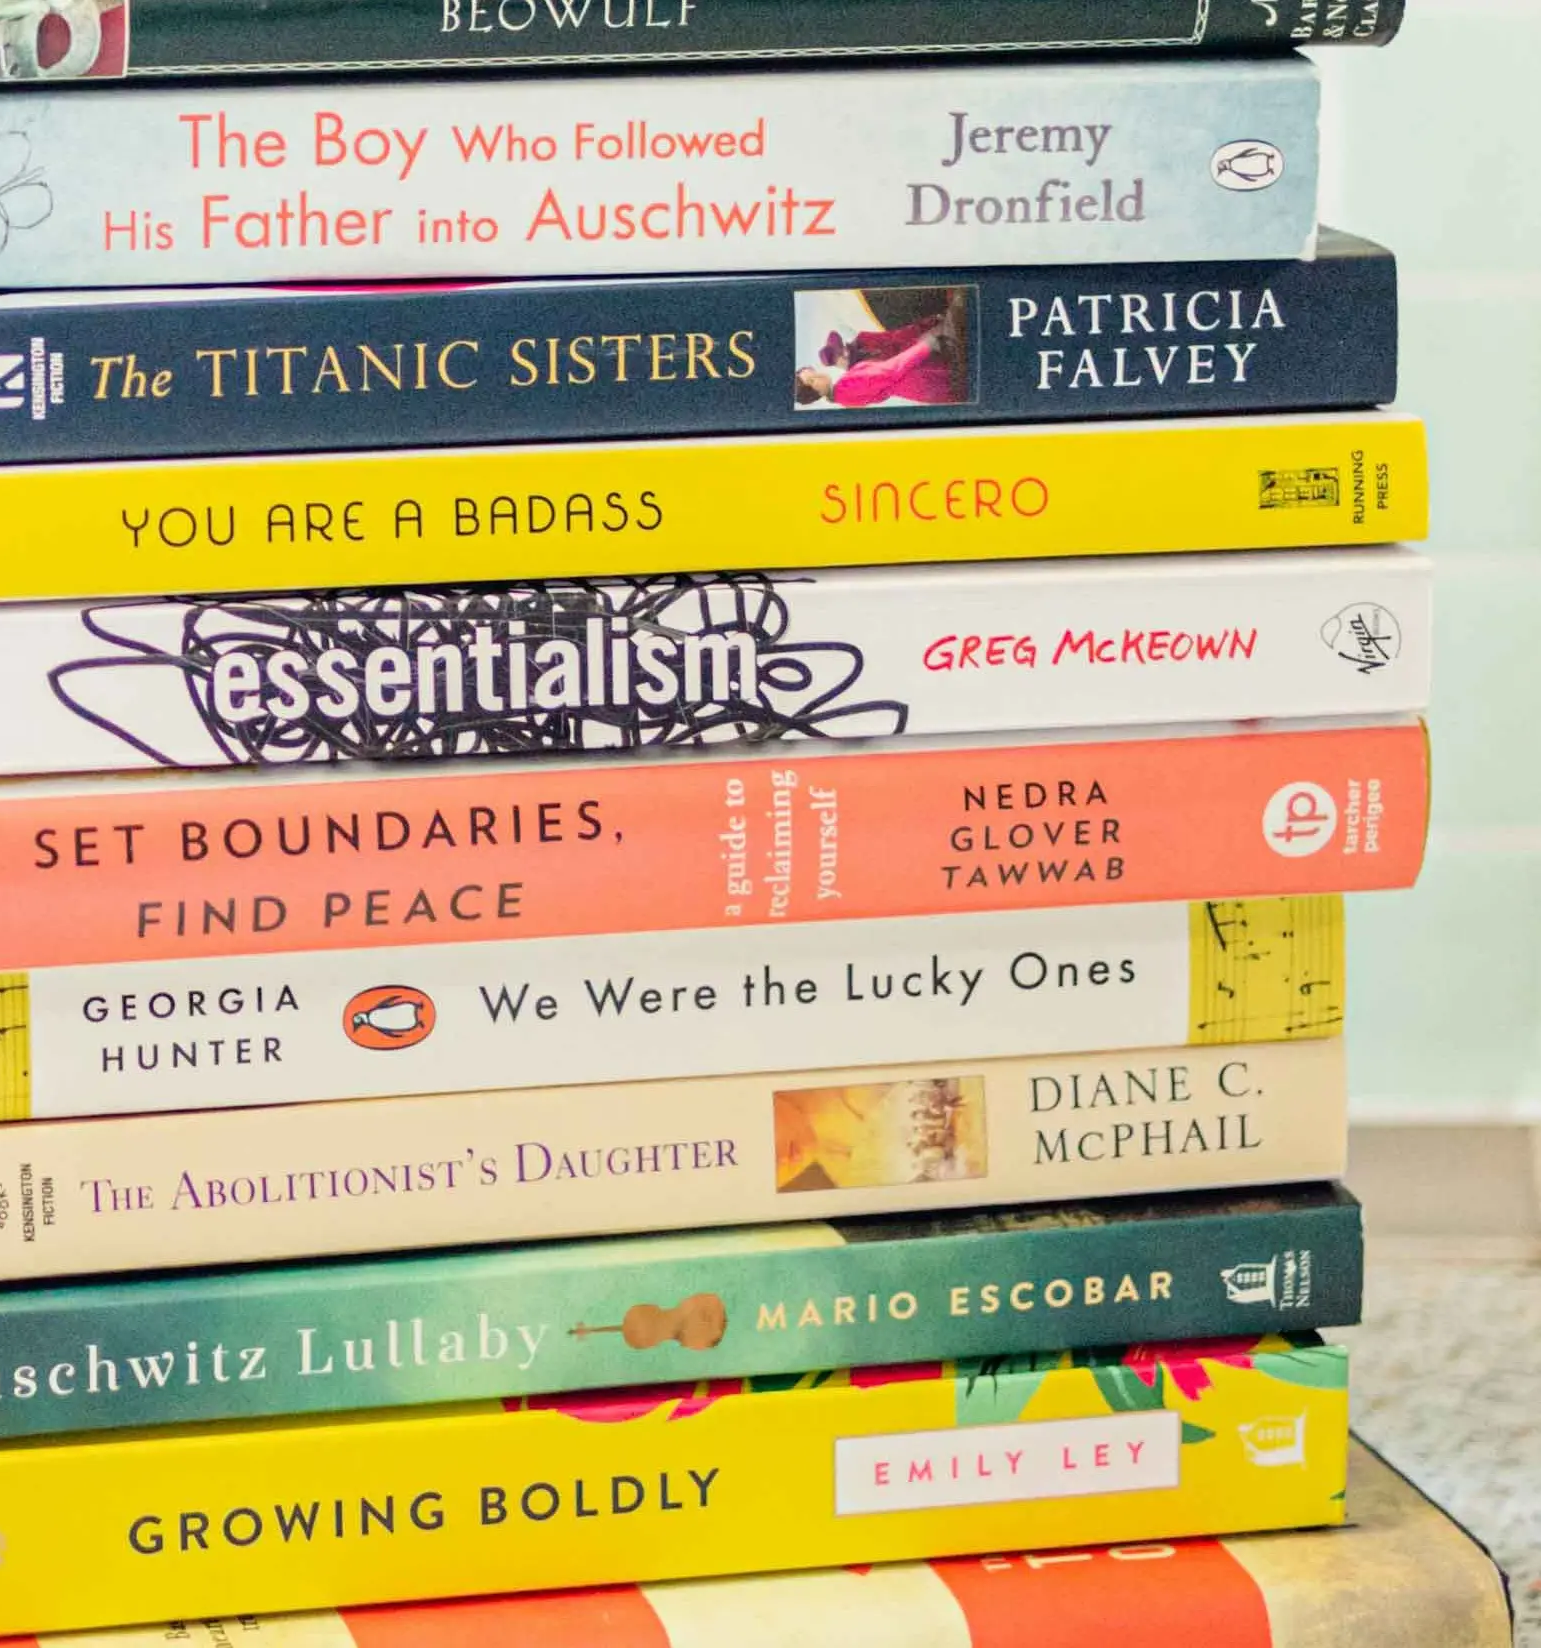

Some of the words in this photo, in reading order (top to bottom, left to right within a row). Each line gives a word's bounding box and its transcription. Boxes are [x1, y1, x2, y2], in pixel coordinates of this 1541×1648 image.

[440, 0, 697, 32] BEOWULF
[179, 114, 286, 168] The
[314, 112, 428, 180] Boy
[453, 124, 557, 163] Who
[575, 117, 765, 160] Followed
[943, 111, 1113, 168] Jeremy
[105, 211, 174, 251] His
[202, 191, 393, 249] Father
[418, 208, 499, 245] into
[527, 183, 837, 242] Auschwitz
[905, 179, 1146, 228] Dronfield
[1007, 288, 1286, 339] PATRICIA
[49, 352, 65, 404] FICTION
[90, 355, 173, 399] The
[196, 339, 479, 398] TITANIC
[509, 330, 756, 387] SISTERS
[1036, 342, 1259, 390] FALVEY
[820, 476, 1050, 524] SINCERO
[1351, 449, 1365, 525] RUNNING
[1375, 463, 1389, 510] PRESS
[121, 506, 236, 549] YOU
[266, 501, 365, 543] ARE
[394, 499, 424, 539] A
[454, 490, 664, 538] BADASS
[213, 616, 759, 724] essentialism
[922, 631, 1037, 674] GREG
[1338, 613, 1392, 674] Virgin
[725, 778, 746, 807] to
[964, 779, 1108, 812] NEDRA
[1342, 778, 1361, 855] tarcher
[1363, 778, 1384, 854] perigee
[35, 824, 145, 871] SET
[181, 799, 624, 863] BOUNDARIES,
[719, 815, 753, 896] guide
[763, 769, 799, 917] reclaiming
[810, 785, 842, 900] yourself
[950, 818, 1122, 853] GLOVER
[941, 856, 1126, 890] TAWWAB
[136, 894, 290, 939] FIND
[323, 882, 525, 930] PEACE
[725, 904, 742, 916] a
[83, 985, 299, 1023] GEORGIA
[480, 985, 557, 1023] We
[585, 974, 717, 1015] Were
[743, 967, 817, 1007] the
[847, 957, 985, 1008] Lucky
[1010, 950, 1138, 991] Ones
[101, 1037, 284, 1072] HUNTER
[1030, 1066, 1193, 1114] DIANE
[1217, 1061, 1263, 1098] C.
[20, 1162, 35, 1242] KENSINGTON
[42, 1177, 56, 1226] FICTION
[80, 1177, 155, 1214] THE
[513, 1138, 737, 1185] DAUGHTER
[757, 1290, 918, 1332] MARIO
[950, 1270, 1174, 1317] ESCOBAR
[298, 1314, 550, 1377] Lullaby
[875, 1450, 1026, 1488] EMILY
[1063, 1441, 1147, 1472] LEY
[128, 1490, 445, 1556] GROWING
[482, 1469, 719, 1525] BOLDLY
